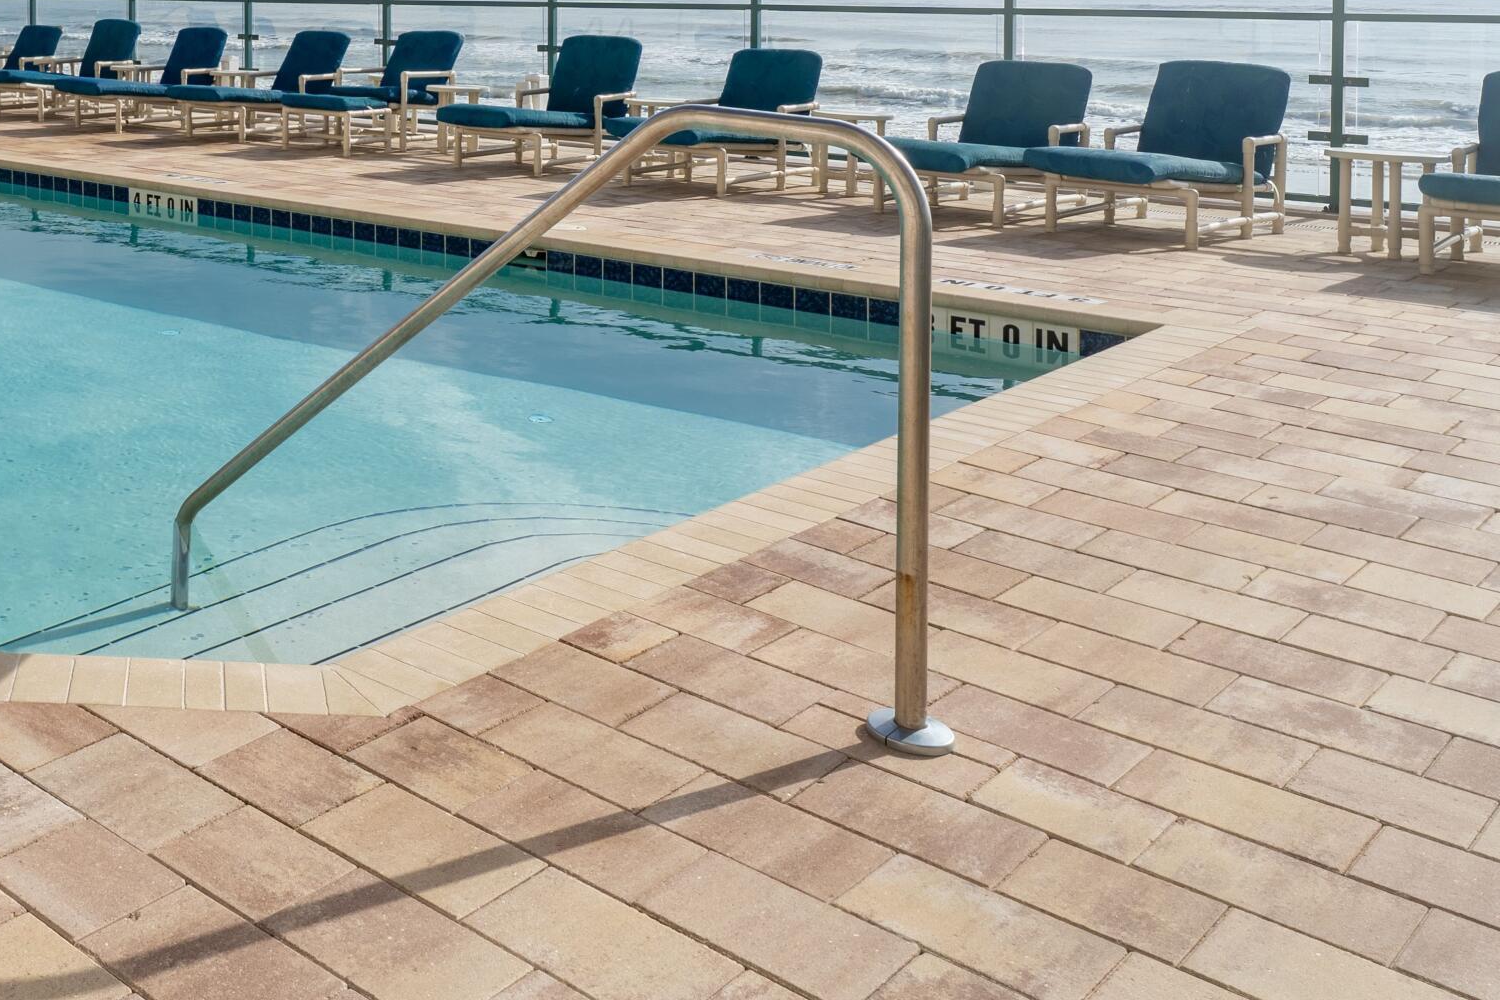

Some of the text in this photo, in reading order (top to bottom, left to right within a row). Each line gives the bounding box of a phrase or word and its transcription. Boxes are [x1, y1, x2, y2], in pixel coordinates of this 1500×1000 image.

[180, 198, 193, 213] IN
[1002, 323, 1020, 346] 0
[1035, 327, 1069, 353] IN
